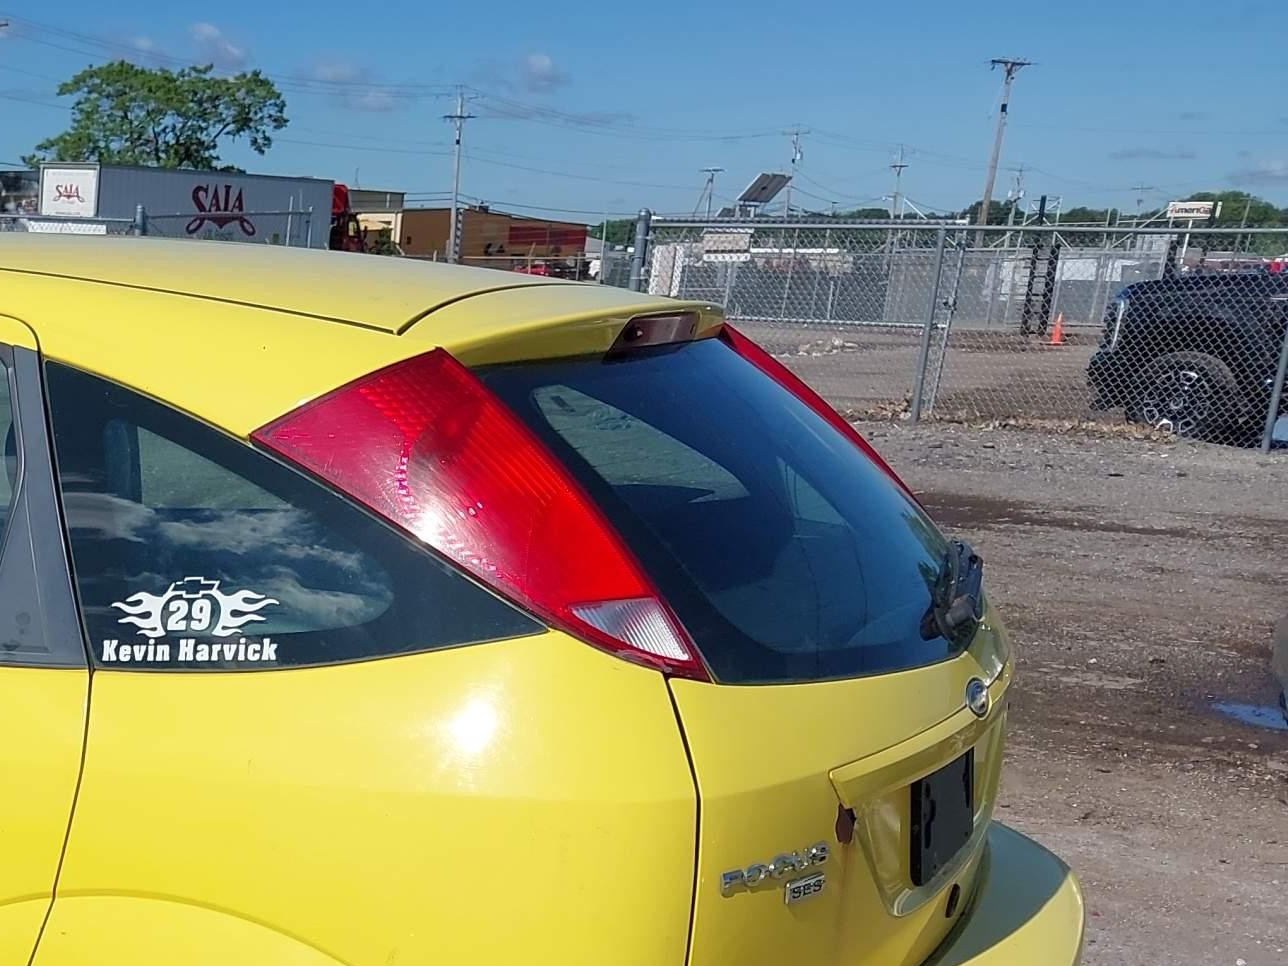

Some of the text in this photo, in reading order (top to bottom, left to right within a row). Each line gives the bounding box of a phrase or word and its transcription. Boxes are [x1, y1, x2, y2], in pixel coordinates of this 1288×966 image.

[53, 184, 85, 203] SAIA
[186, 184, 255, 236] SAIA
[167, 599, 211, 631] 29
[102, 638, 278, 662] Kevin Harvick
[791, 880, 824, 899] SES
